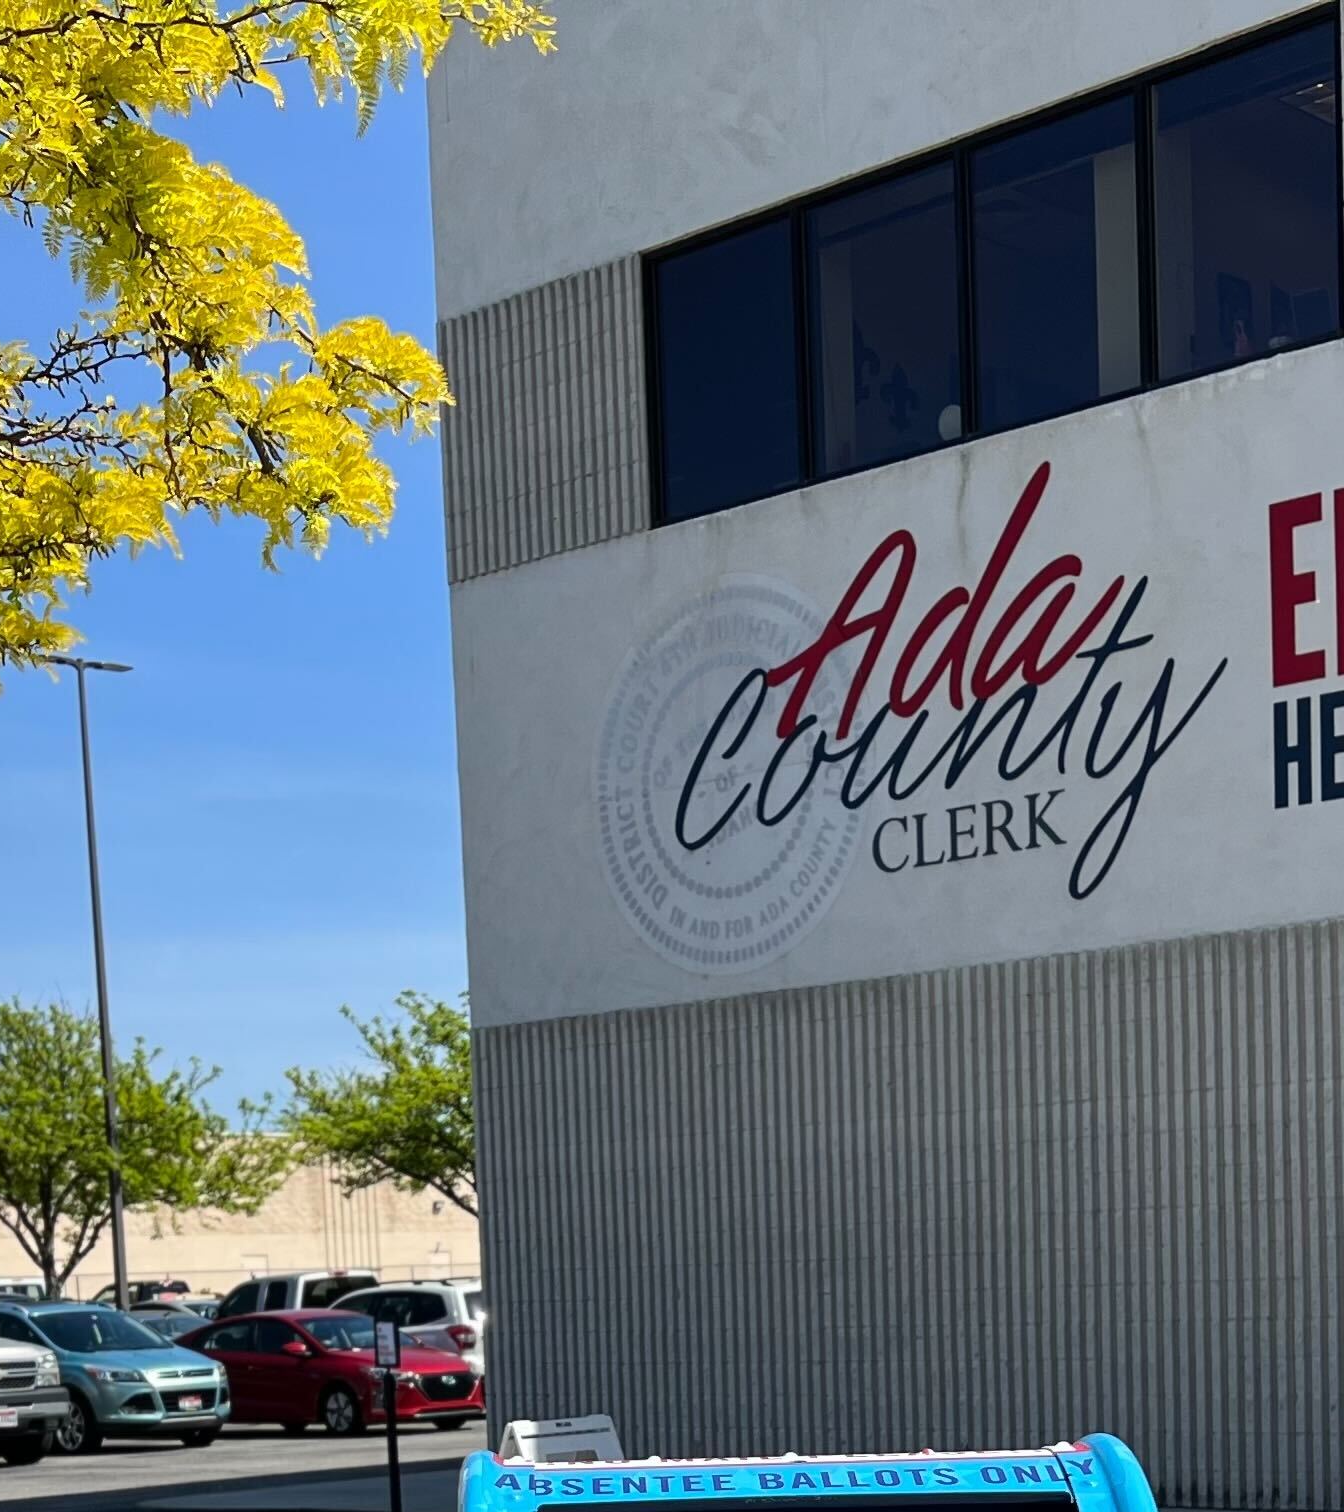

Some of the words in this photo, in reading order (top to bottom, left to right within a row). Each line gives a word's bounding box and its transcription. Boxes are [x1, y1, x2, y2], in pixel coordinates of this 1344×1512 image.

[764, 460, 1125, 740] Ada
[674, 575, 1229, 900] County
[686, 916, 721, 941] AND
[724, 914, 753, 940] FOR
[758, 894, 790, 927] ADA
[787, 816, 838, 900] COUNTY
[871, 787, 1068, 873] CLERK
[494, 1472, 737, 1497] ABSENTEE
[757, 1467, 960, 1491] BALLOTS
[980, 1457, 1096, 1485] ONLY
